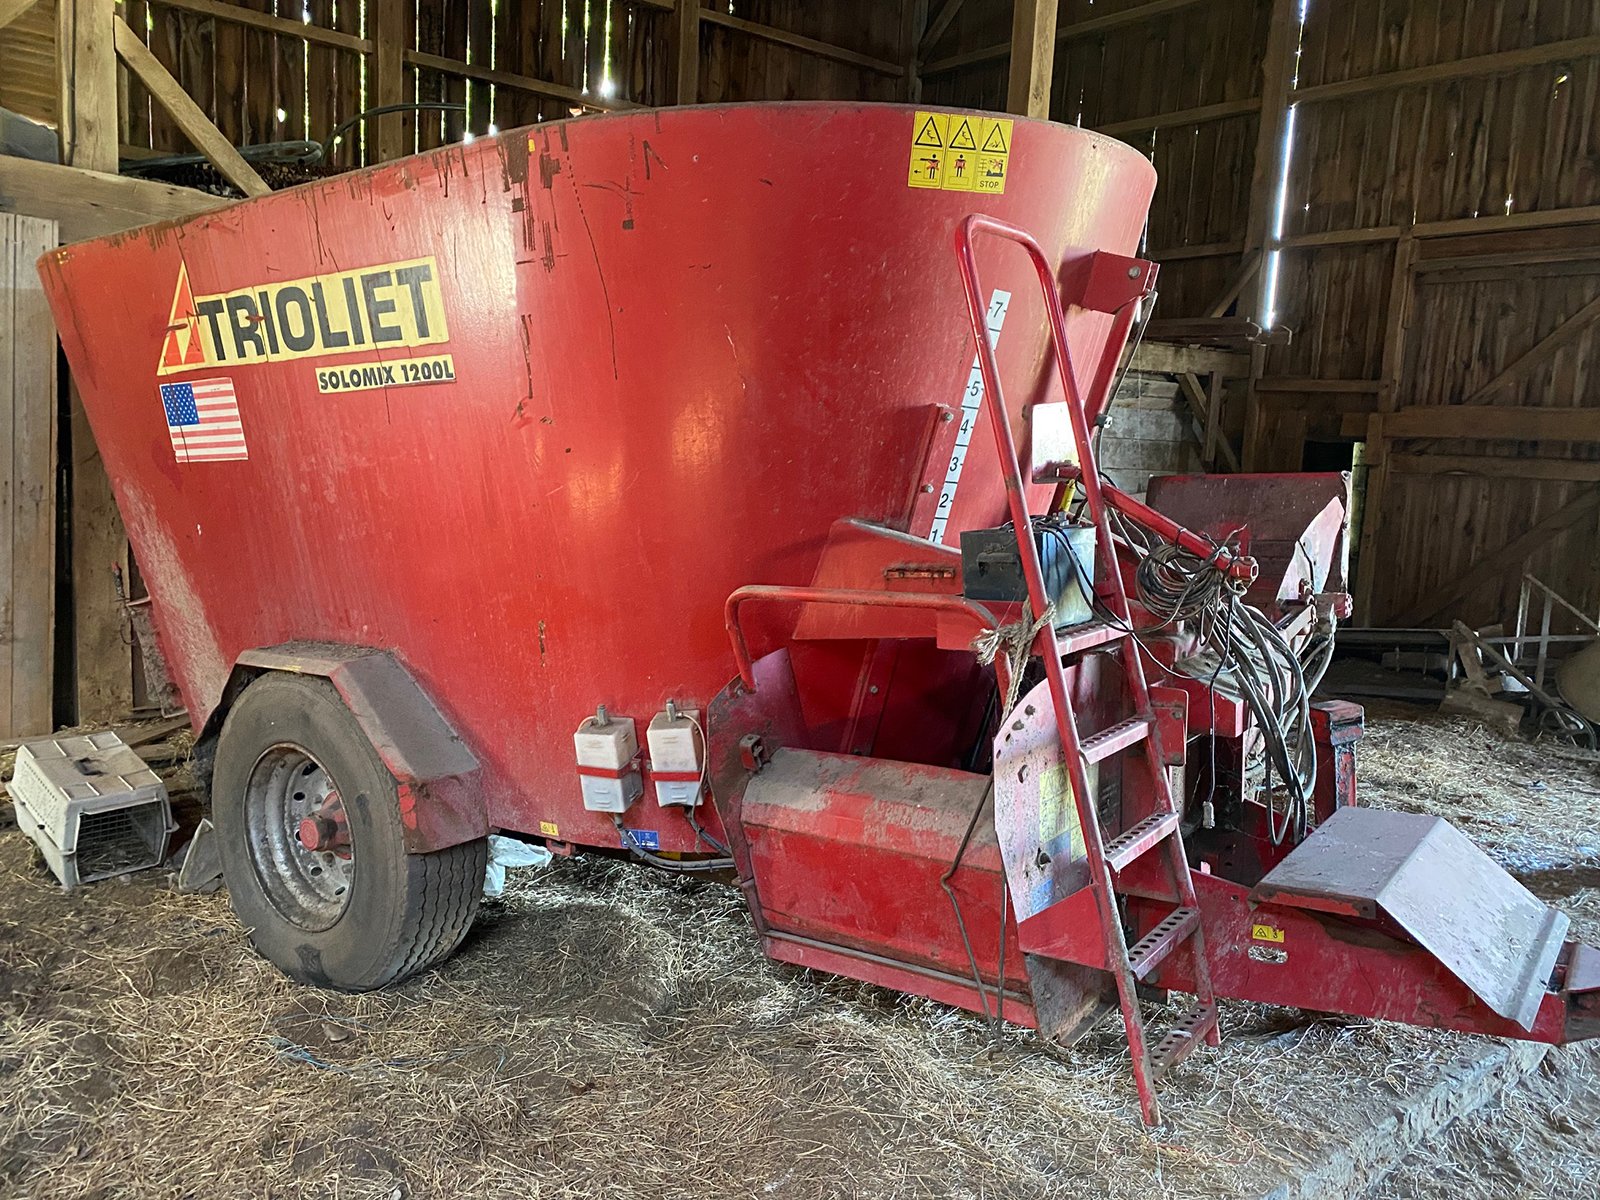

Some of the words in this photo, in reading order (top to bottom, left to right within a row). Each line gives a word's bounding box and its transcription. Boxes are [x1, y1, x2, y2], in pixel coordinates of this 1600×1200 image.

[979, 180, 999, 188] STOP
[197, 264, 432, 361] TRIOLIET
[993, 301, 1003, 319] 7
[319, 366, 396, 390] SOLOMIX
[401, 360, 454, 382] 1200L
[970, 381, 980, 397] 5
[960, 419, 970, 434] 4
[949, 457, 959, 472] 3
[938, 493, 949, 508] 2
[931, 529, 938, 543] 1
